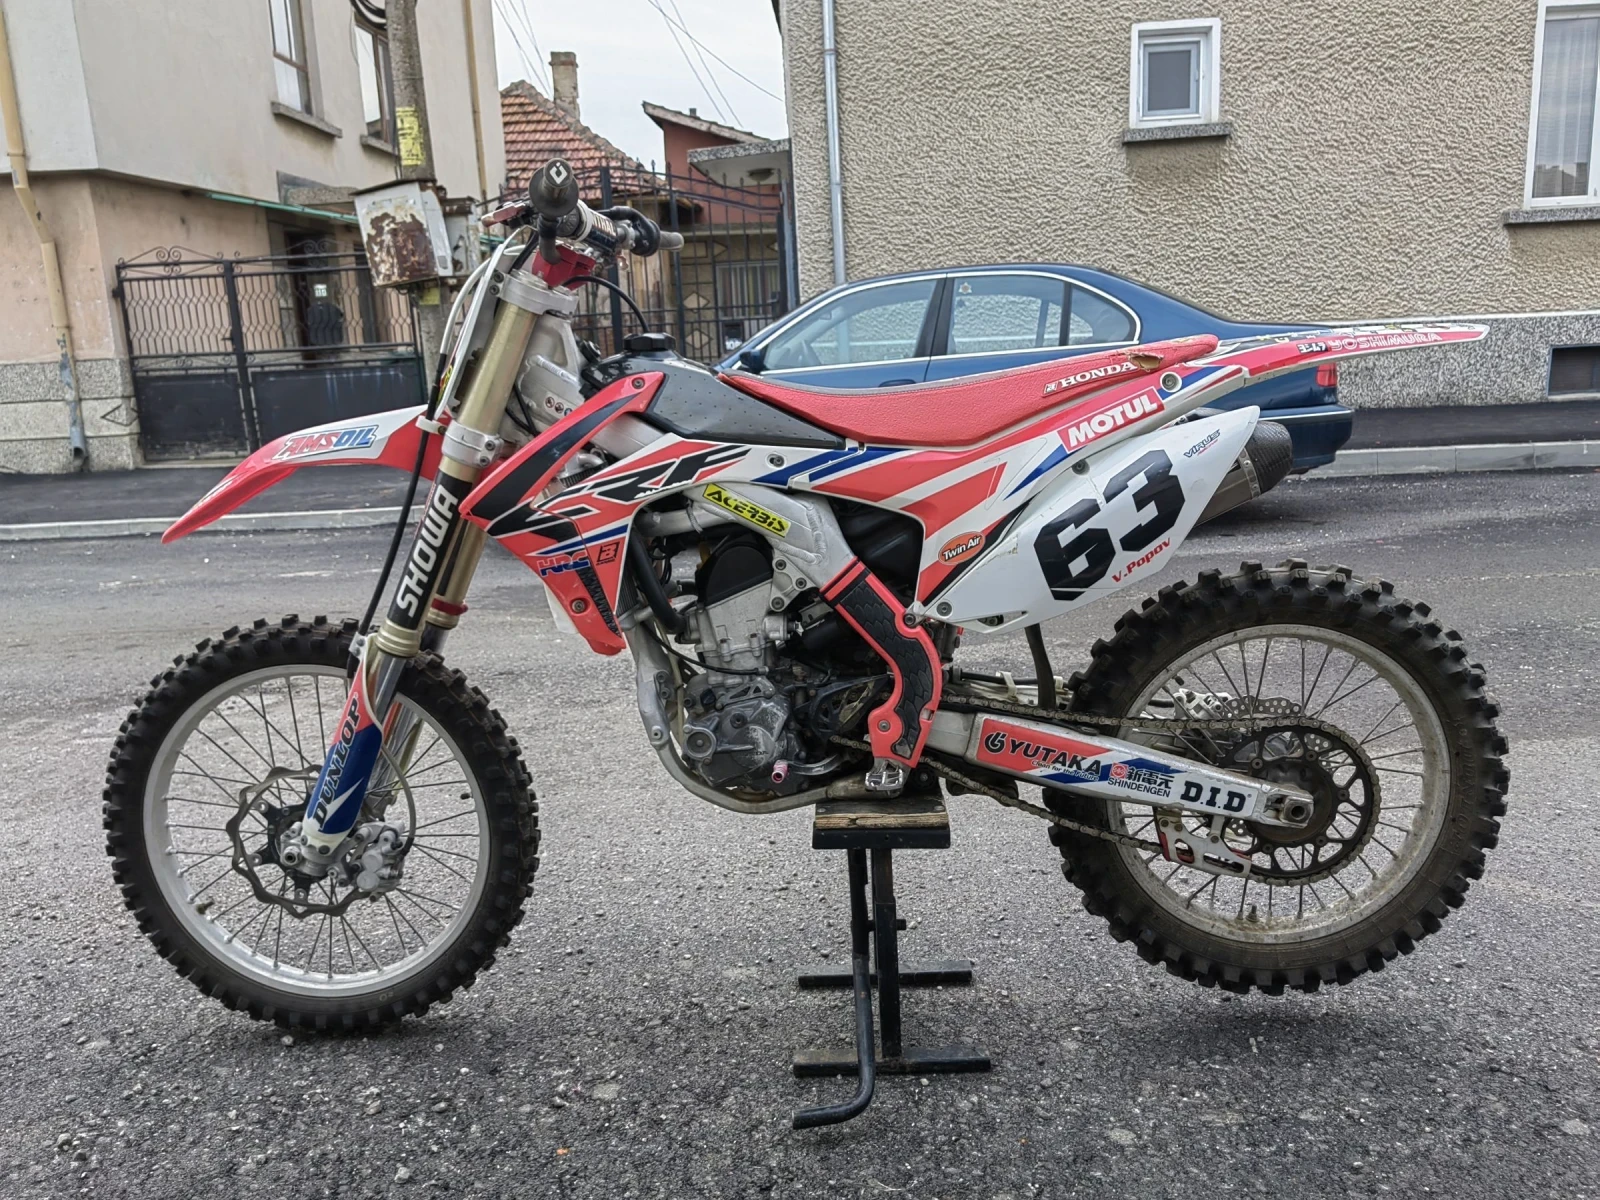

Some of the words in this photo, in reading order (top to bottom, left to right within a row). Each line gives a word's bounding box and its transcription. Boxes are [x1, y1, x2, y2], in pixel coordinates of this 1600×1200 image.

[1327, 332, 1443, 351] YOSHIMURA
[1060, 361, 1138, 388] HONDA
[1068, 394, 1158, 447] MOTUL
[274, 427, 375, 460] AMSOIL
[1183, 428, 1221, 458] VIRUS
[1033, 449, 1186, 601] 63
[396, 484, 458, 618] SHOWA
[536, 549, 591, 577] HRC
[942, 541, 967, 561] Twin
[967, 535, 982, 550] Air
[313, 695, 361, 831] DUNLOP
[1009, 738, 1102, 776] YUTAKA
[1107, 777, 1171, 798] SHINDENGEN
[1126, 765, 1175, 789] 新電元
[1180, 780, 1247, 813] D.I.D
